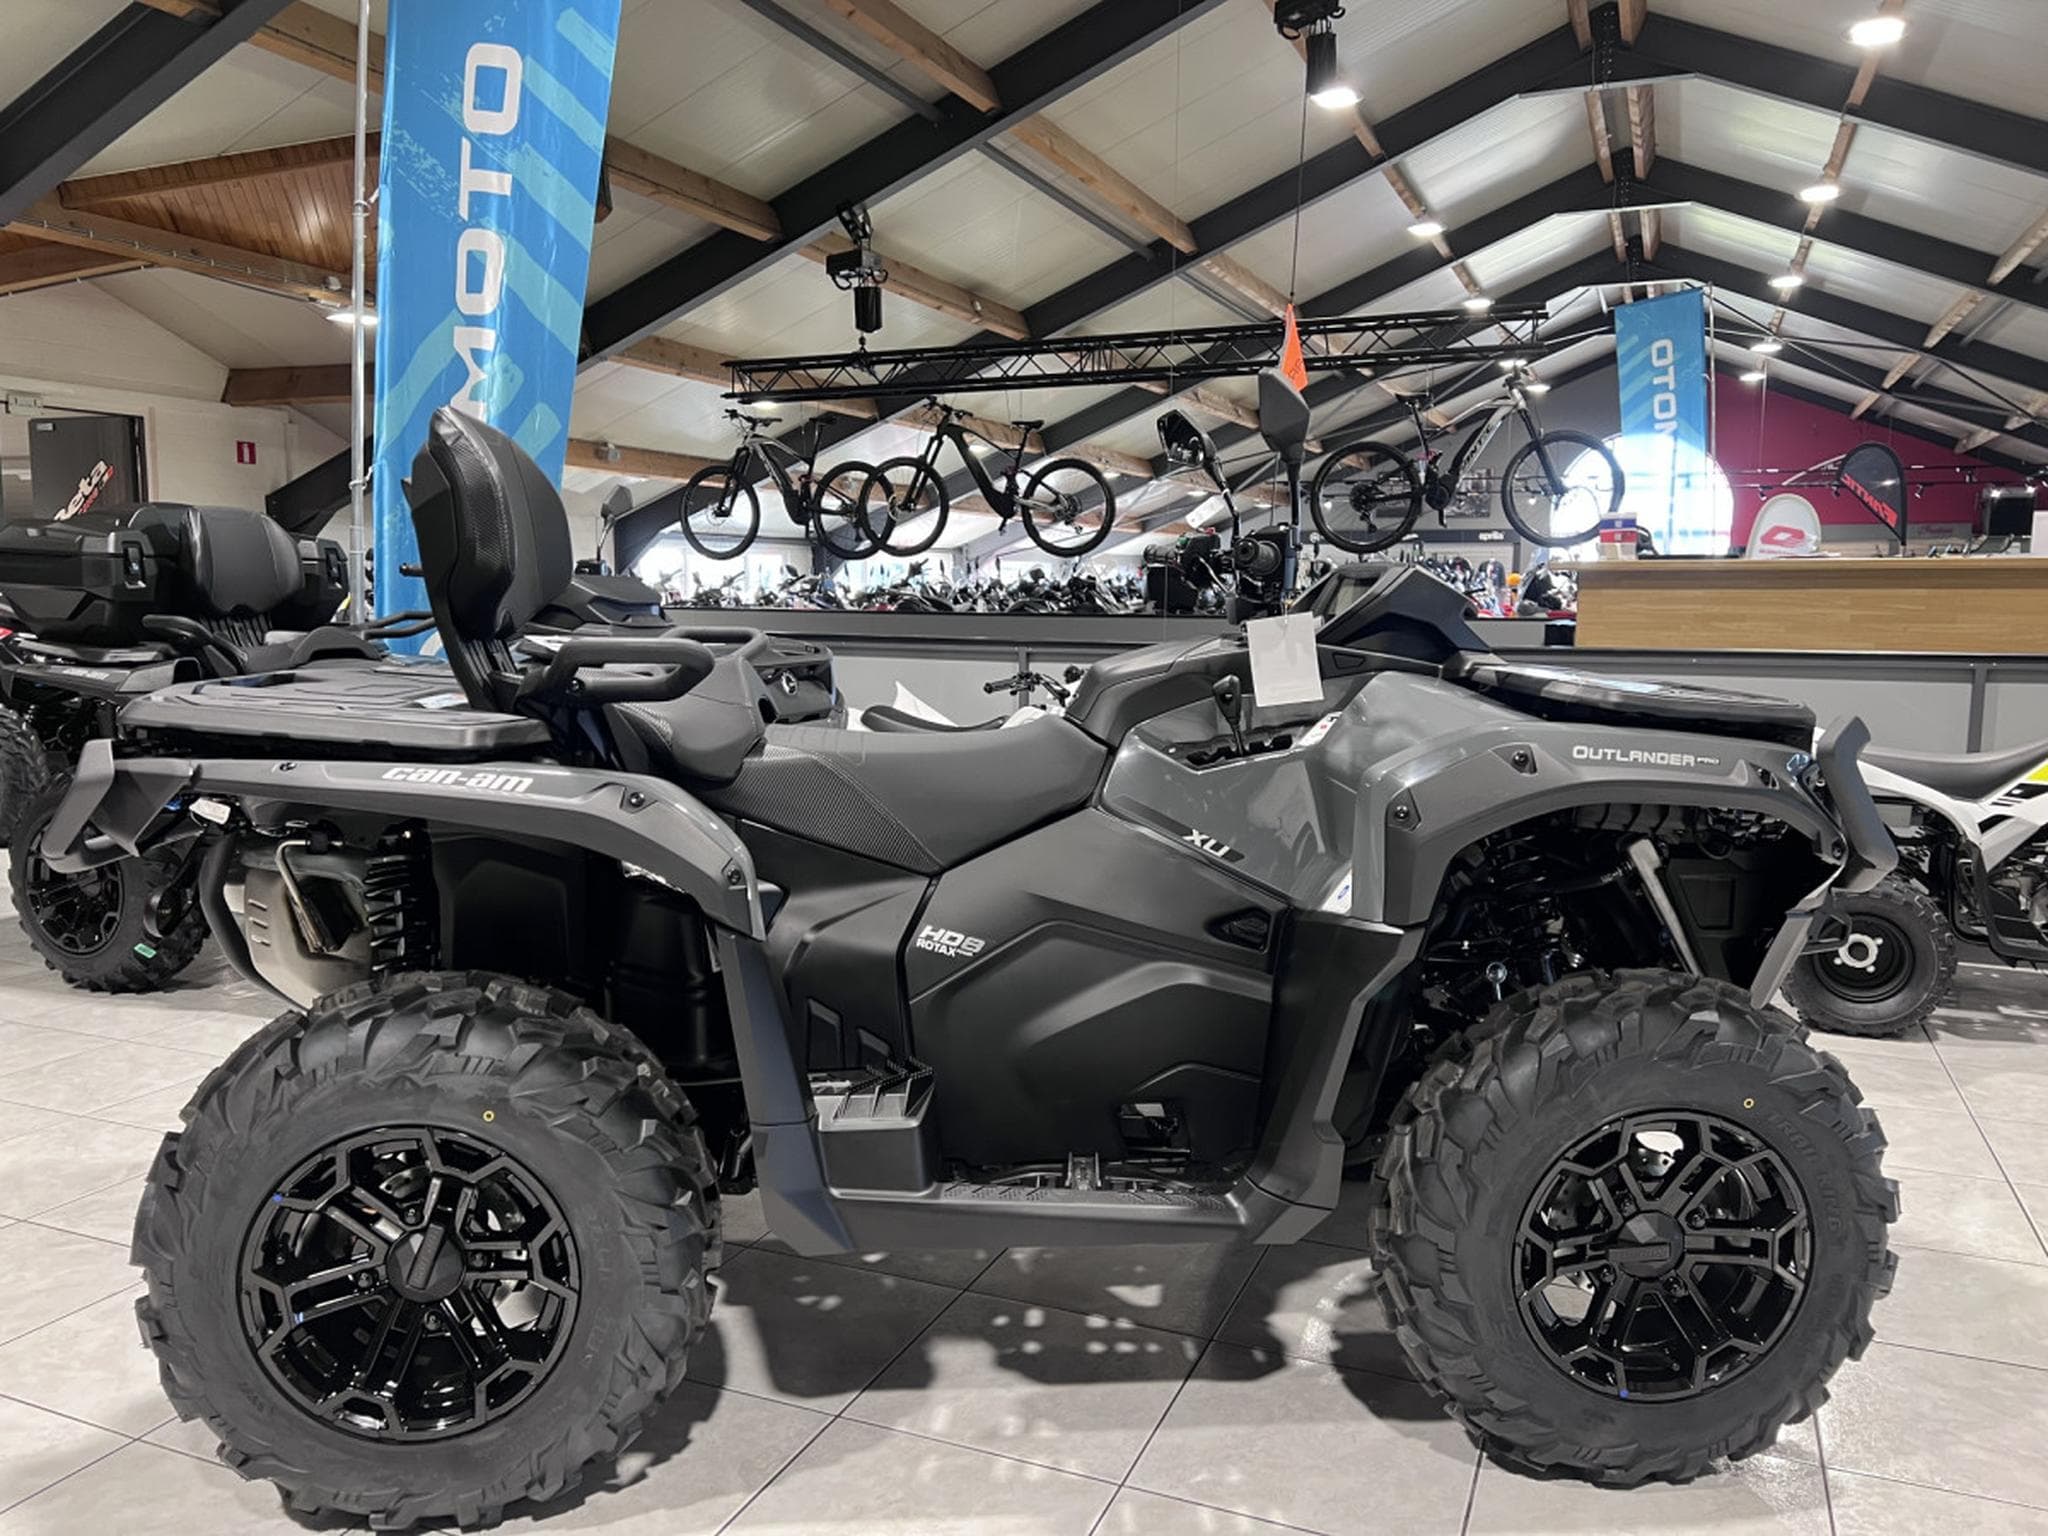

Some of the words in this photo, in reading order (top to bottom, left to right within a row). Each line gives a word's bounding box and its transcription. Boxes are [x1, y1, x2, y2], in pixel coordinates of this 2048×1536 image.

[1572, 745, 1696, 767] OUTLANDER
[916, 938, 957, 957] ROTAX
[919, 925, 986, 953] HD8
